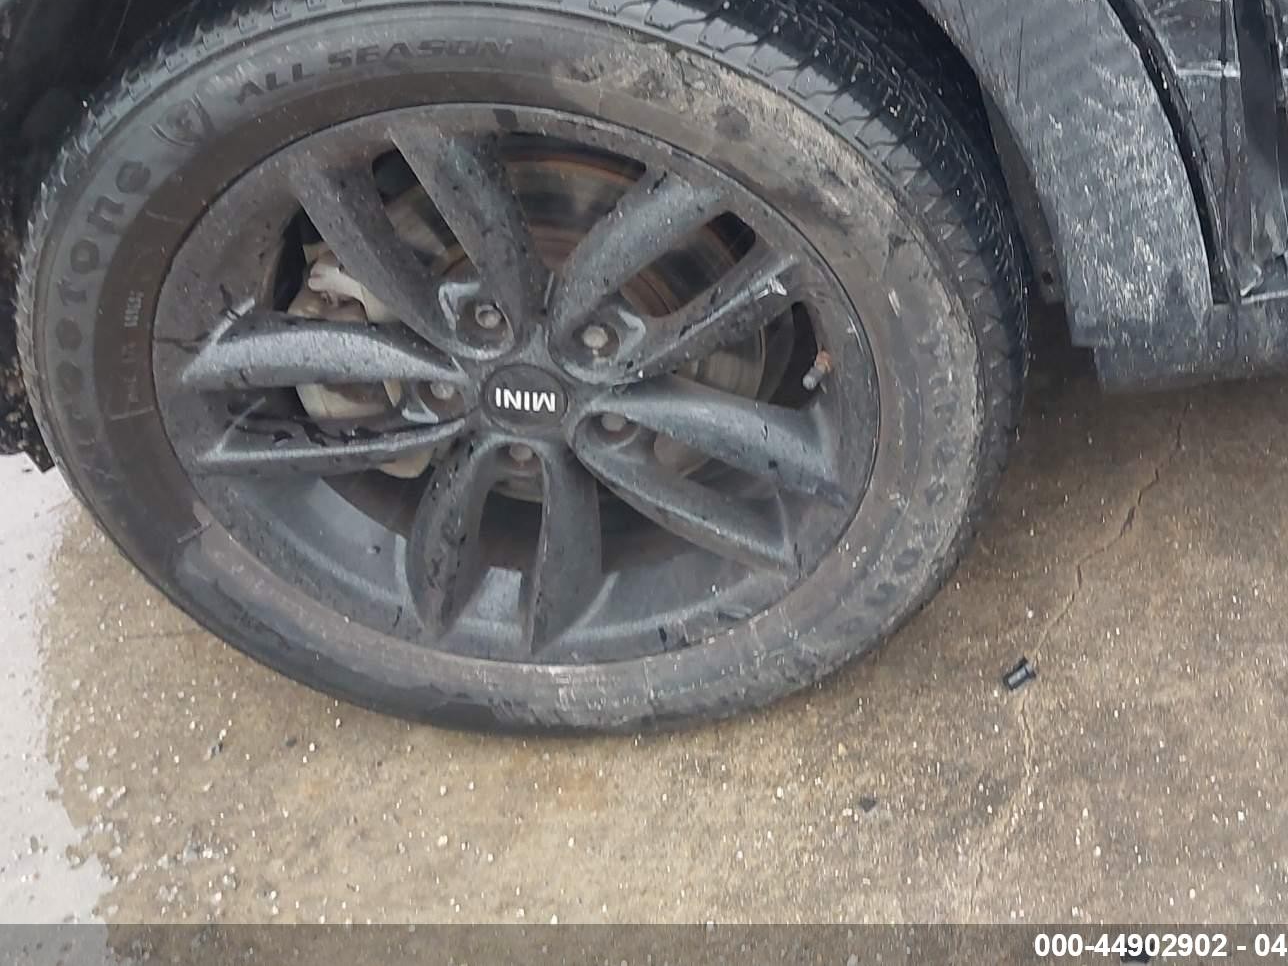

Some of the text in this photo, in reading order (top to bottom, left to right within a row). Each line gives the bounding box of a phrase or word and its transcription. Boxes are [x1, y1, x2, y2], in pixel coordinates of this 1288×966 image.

[234, 37, 514, 107] ALL SEASON
[495, 387, 556, 413] MINI
